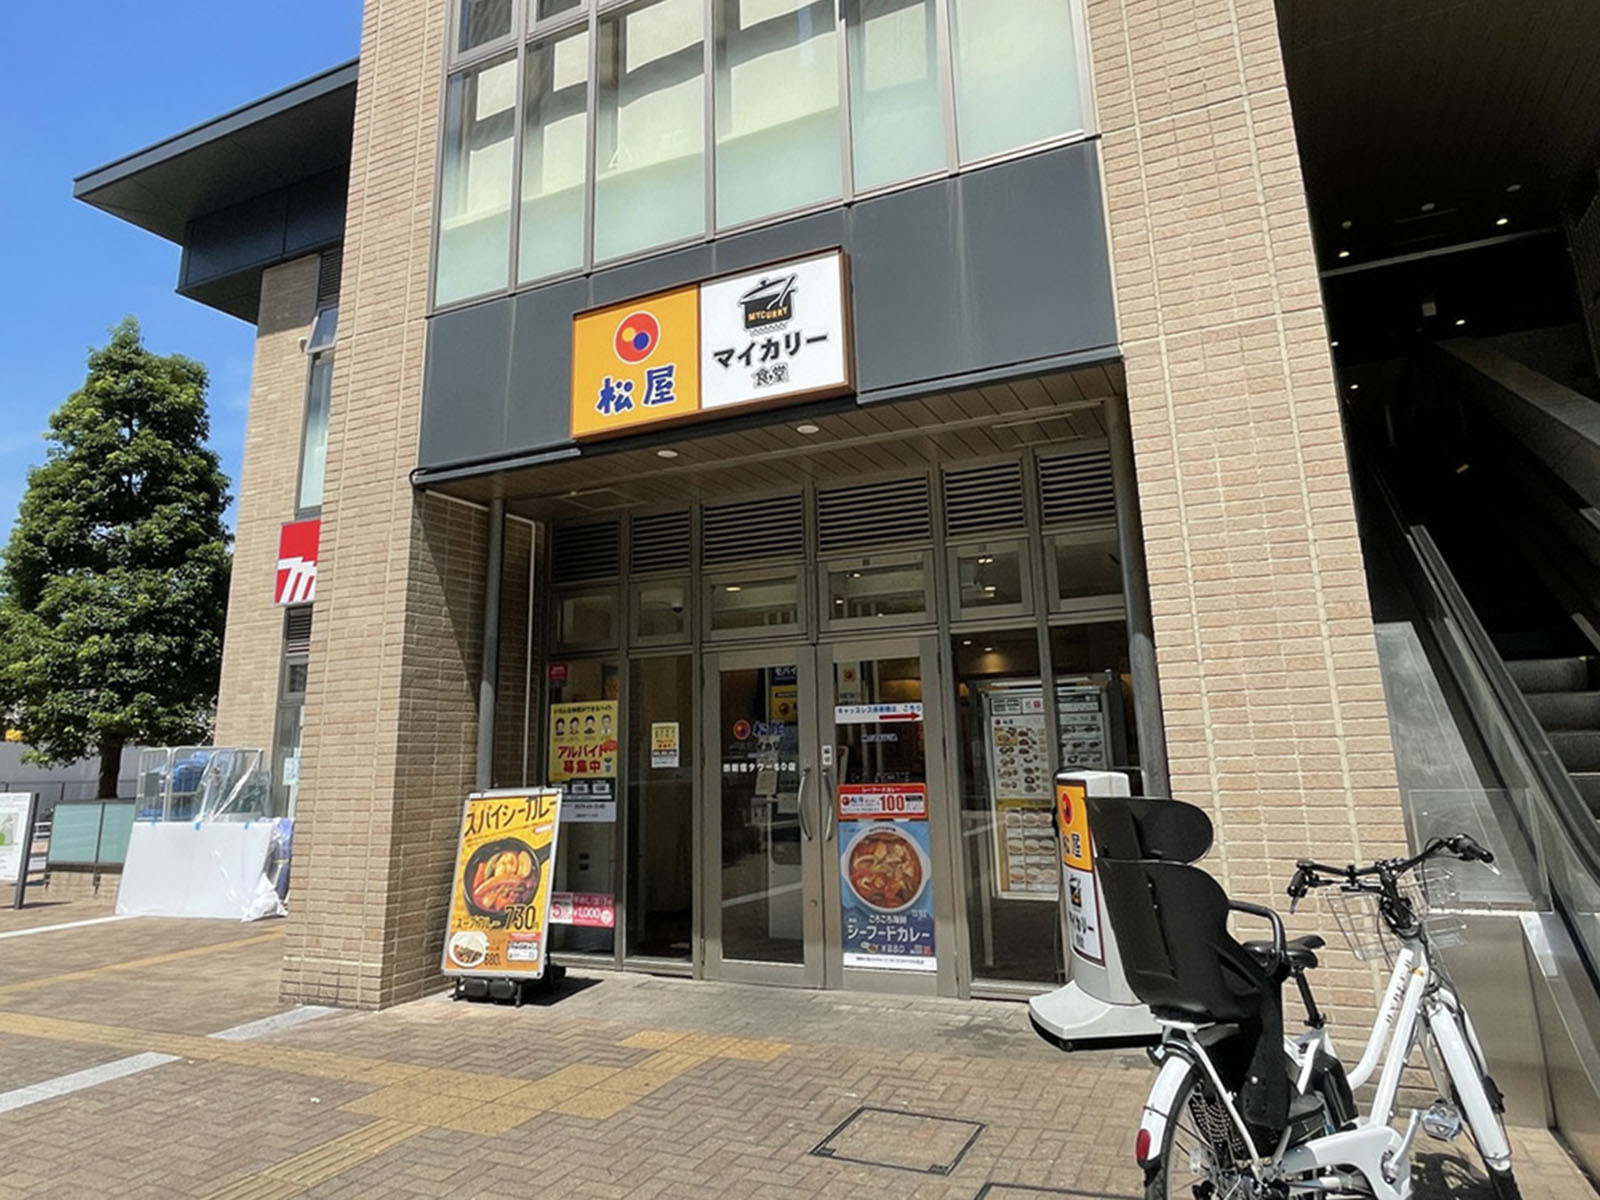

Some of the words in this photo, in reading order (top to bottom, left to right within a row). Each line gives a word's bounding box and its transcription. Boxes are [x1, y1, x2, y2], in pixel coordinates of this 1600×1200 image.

[747, 306, 790, 321] MYCURRY
[713, 332, 828, 368] マイカリー
[754, 363, 788, 387] 食堂
[597, 366, 676, 413] 松屋
[558, 744, 604, 758] アルバイト
[564, 760, 600, 773] 募集中
[880, 795, 904, 811] 100
[464, 796, 557, 837] スパイシーカレー
[848, 924, 930, 942] シーフードカレー
